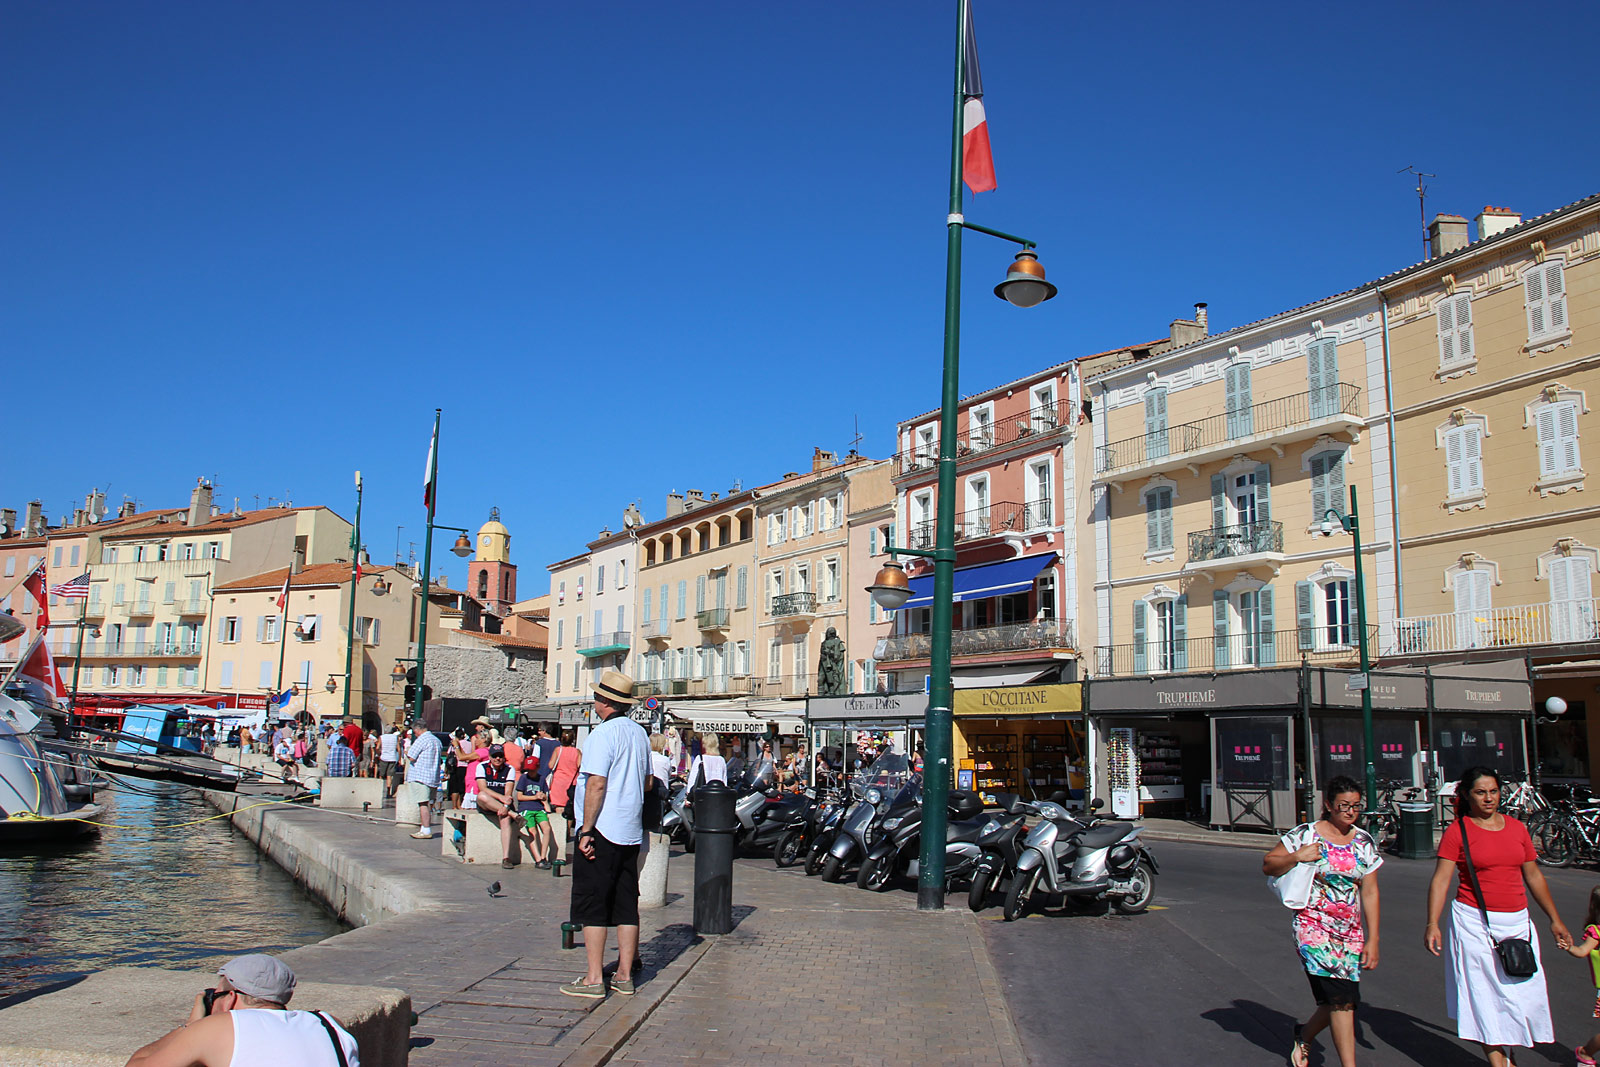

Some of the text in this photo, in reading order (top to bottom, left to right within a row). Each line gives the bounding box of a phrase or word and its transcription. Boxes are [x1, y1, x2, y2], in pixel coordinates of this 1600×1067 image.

[1344, 683, 1397, 694] PMEUR
[983, 690, 1048, 706] L'OCCITANE
[1156, 689, 1216, 704] TRUPHEME
[875, 698, 901, 710] PARIS
[695, 722, 764, 733] PASSAGE DU PORT
